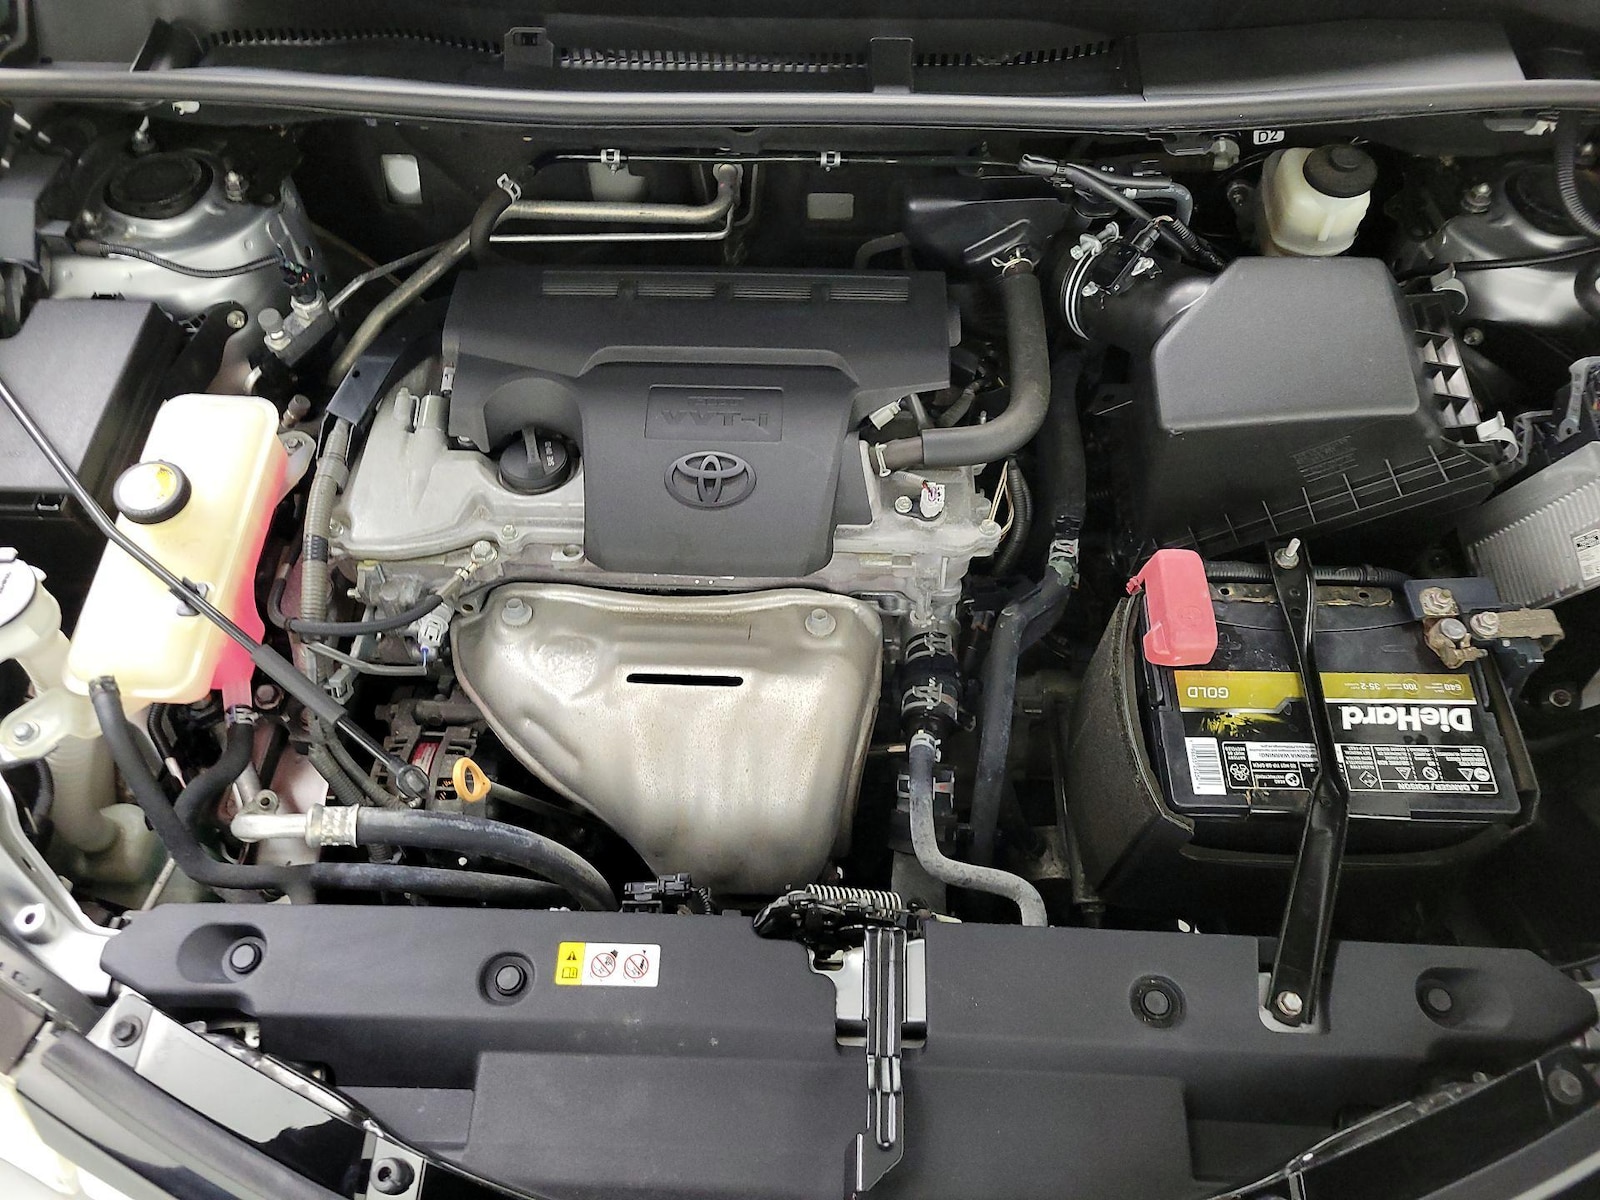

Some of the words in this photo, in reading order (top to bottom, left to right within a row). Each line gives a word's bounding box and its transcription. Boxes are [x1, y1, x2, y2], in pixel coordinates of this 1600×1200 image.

[1258, 130, 1278, 143] D2
[1187, 686, 1229, 698] GOLD
[1359, 682, 1381, 691] 35-2
[1402, 683, 1419, 691] 100
[1341, 705, 1473, 733] DieHard
